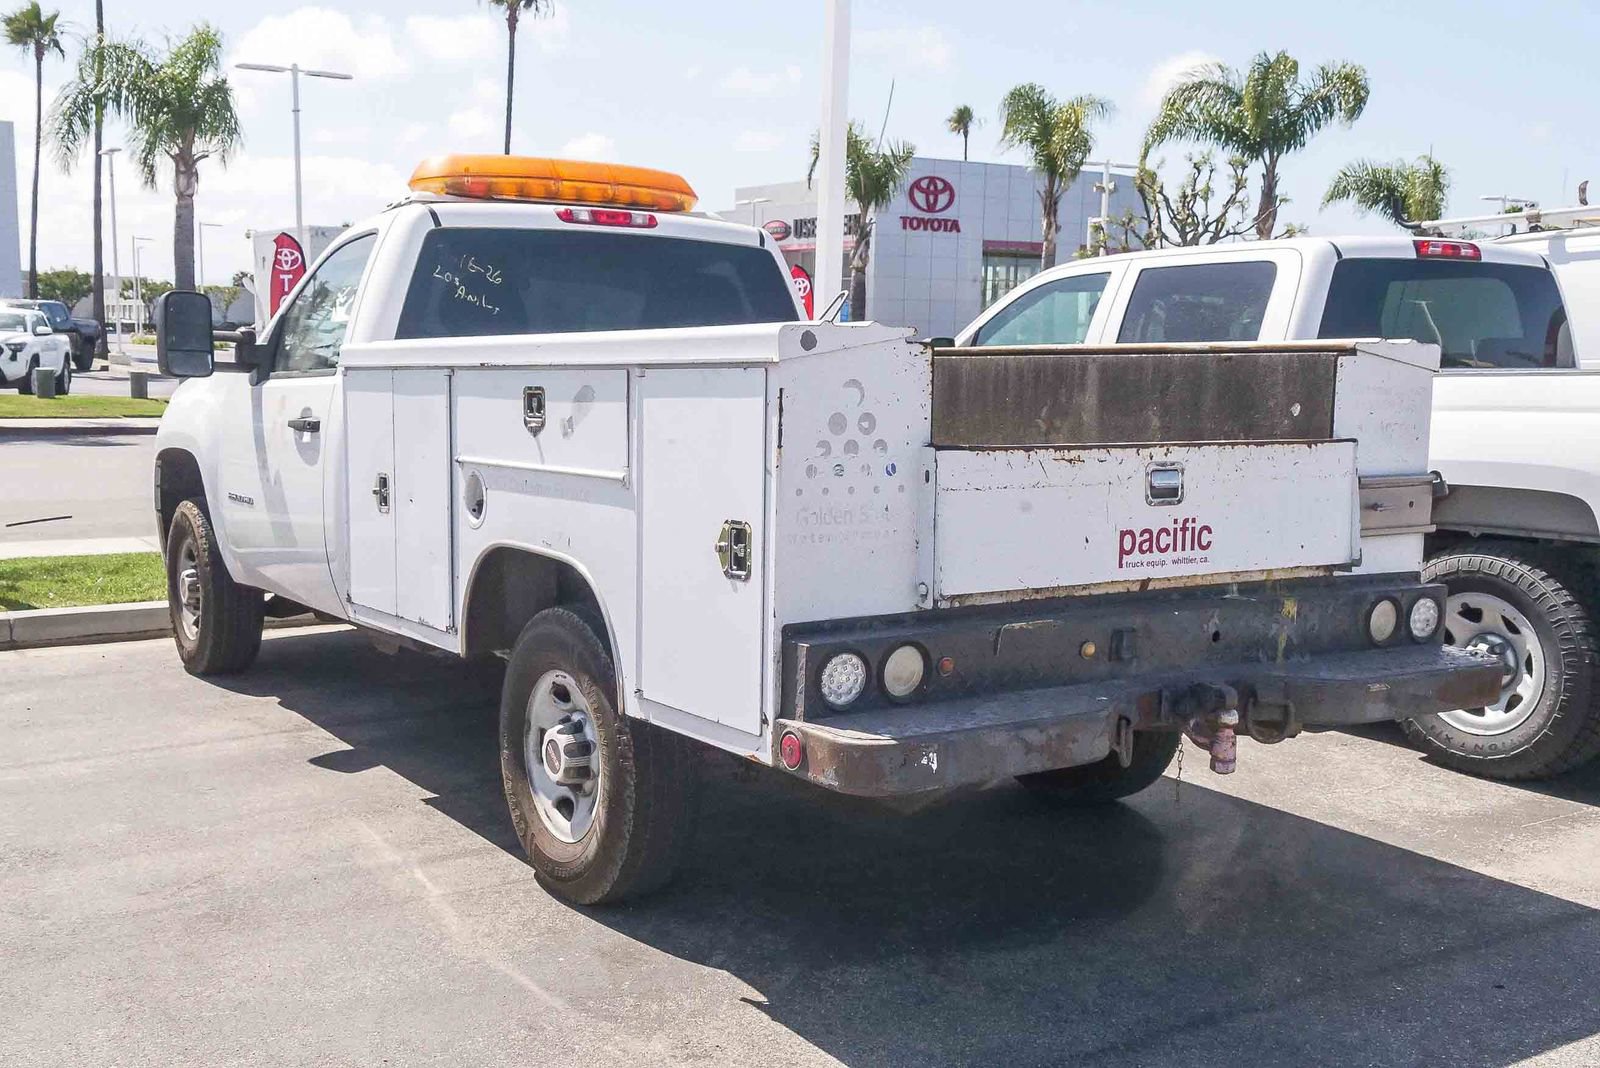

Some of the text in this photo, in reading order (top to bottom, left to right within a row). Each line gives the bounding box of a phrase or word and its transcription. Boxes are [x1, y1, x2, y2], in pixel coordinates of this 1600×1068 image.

[899, 215, 961, 232] TOYOTA
[1118, 516, 1212, 568] pacific
[1125, 560, 1144, 568] truck
[1146, 559, 1167, 568] equip.
